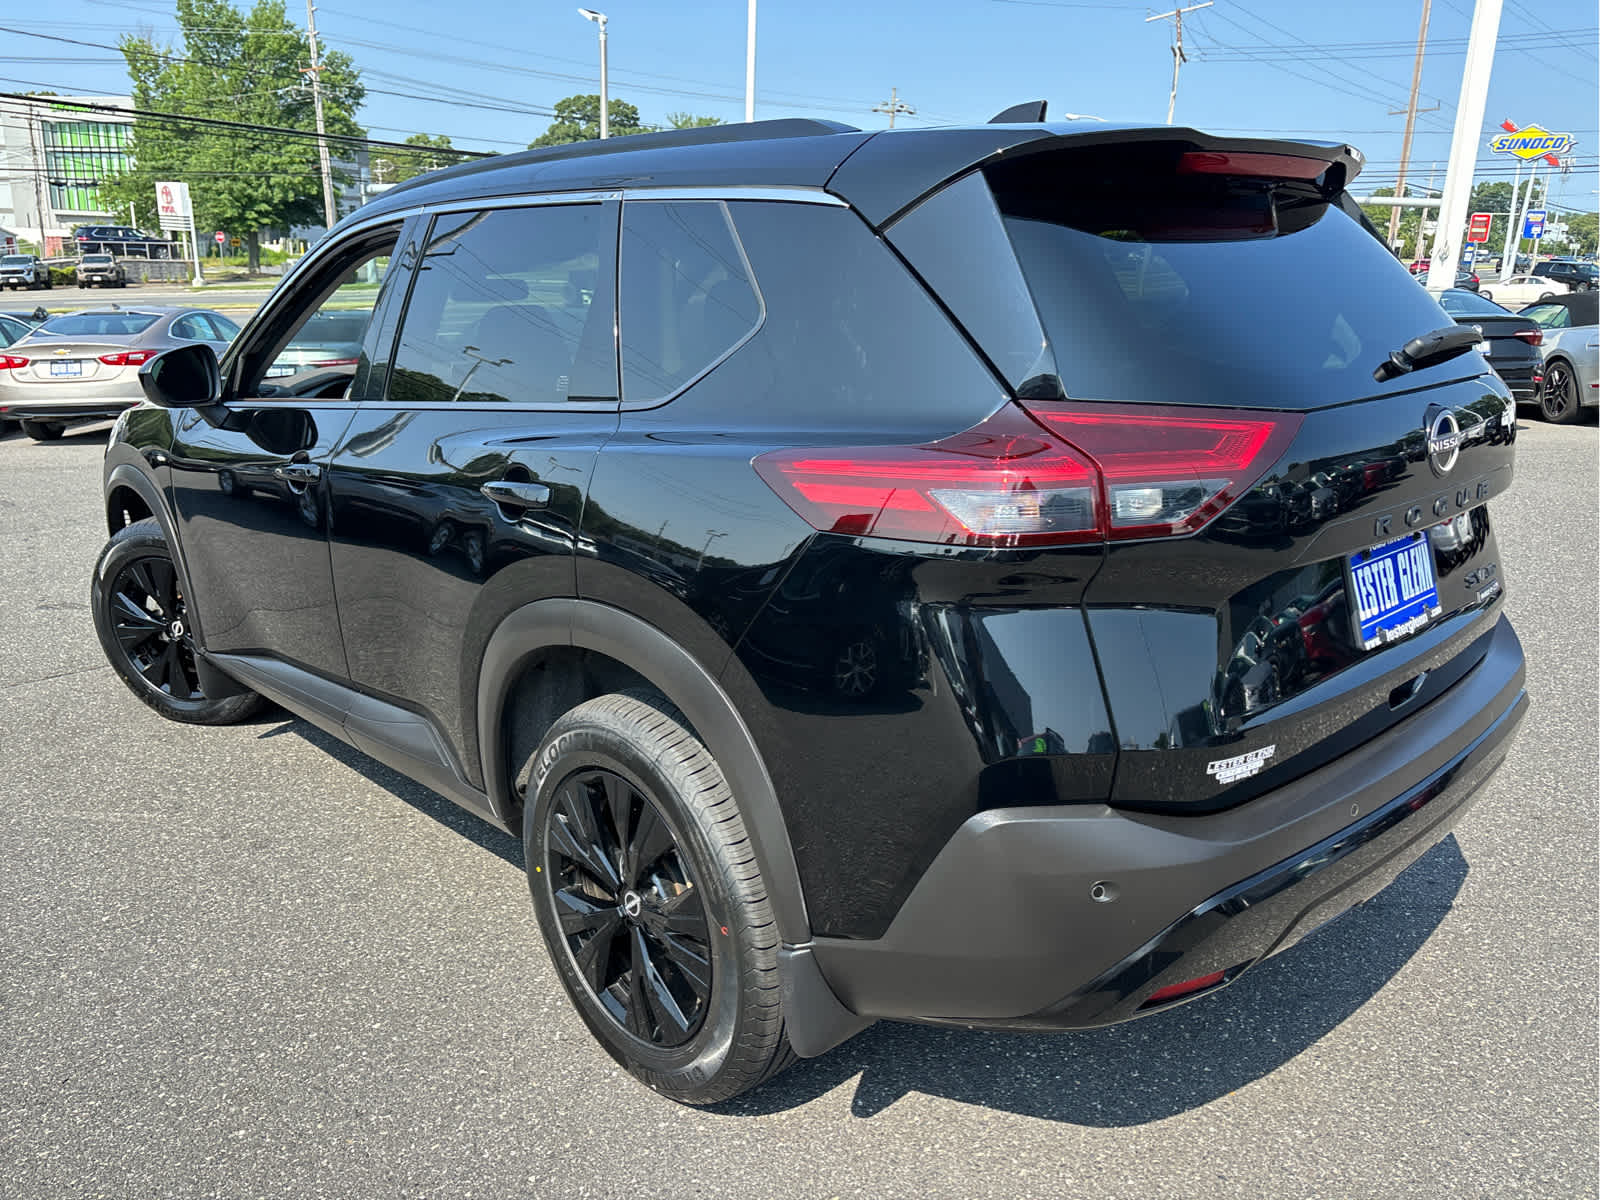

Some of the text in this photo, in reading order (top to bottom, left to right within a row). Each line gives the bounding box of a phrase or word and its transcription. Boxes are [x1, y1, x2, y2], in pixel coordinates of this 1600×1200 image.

[1495, 136, 1566, 151] SUNOCO
[1374, 480, 1489, 537] ROGUE
[1351, 542, 1434, 622] LESTER GLENN
